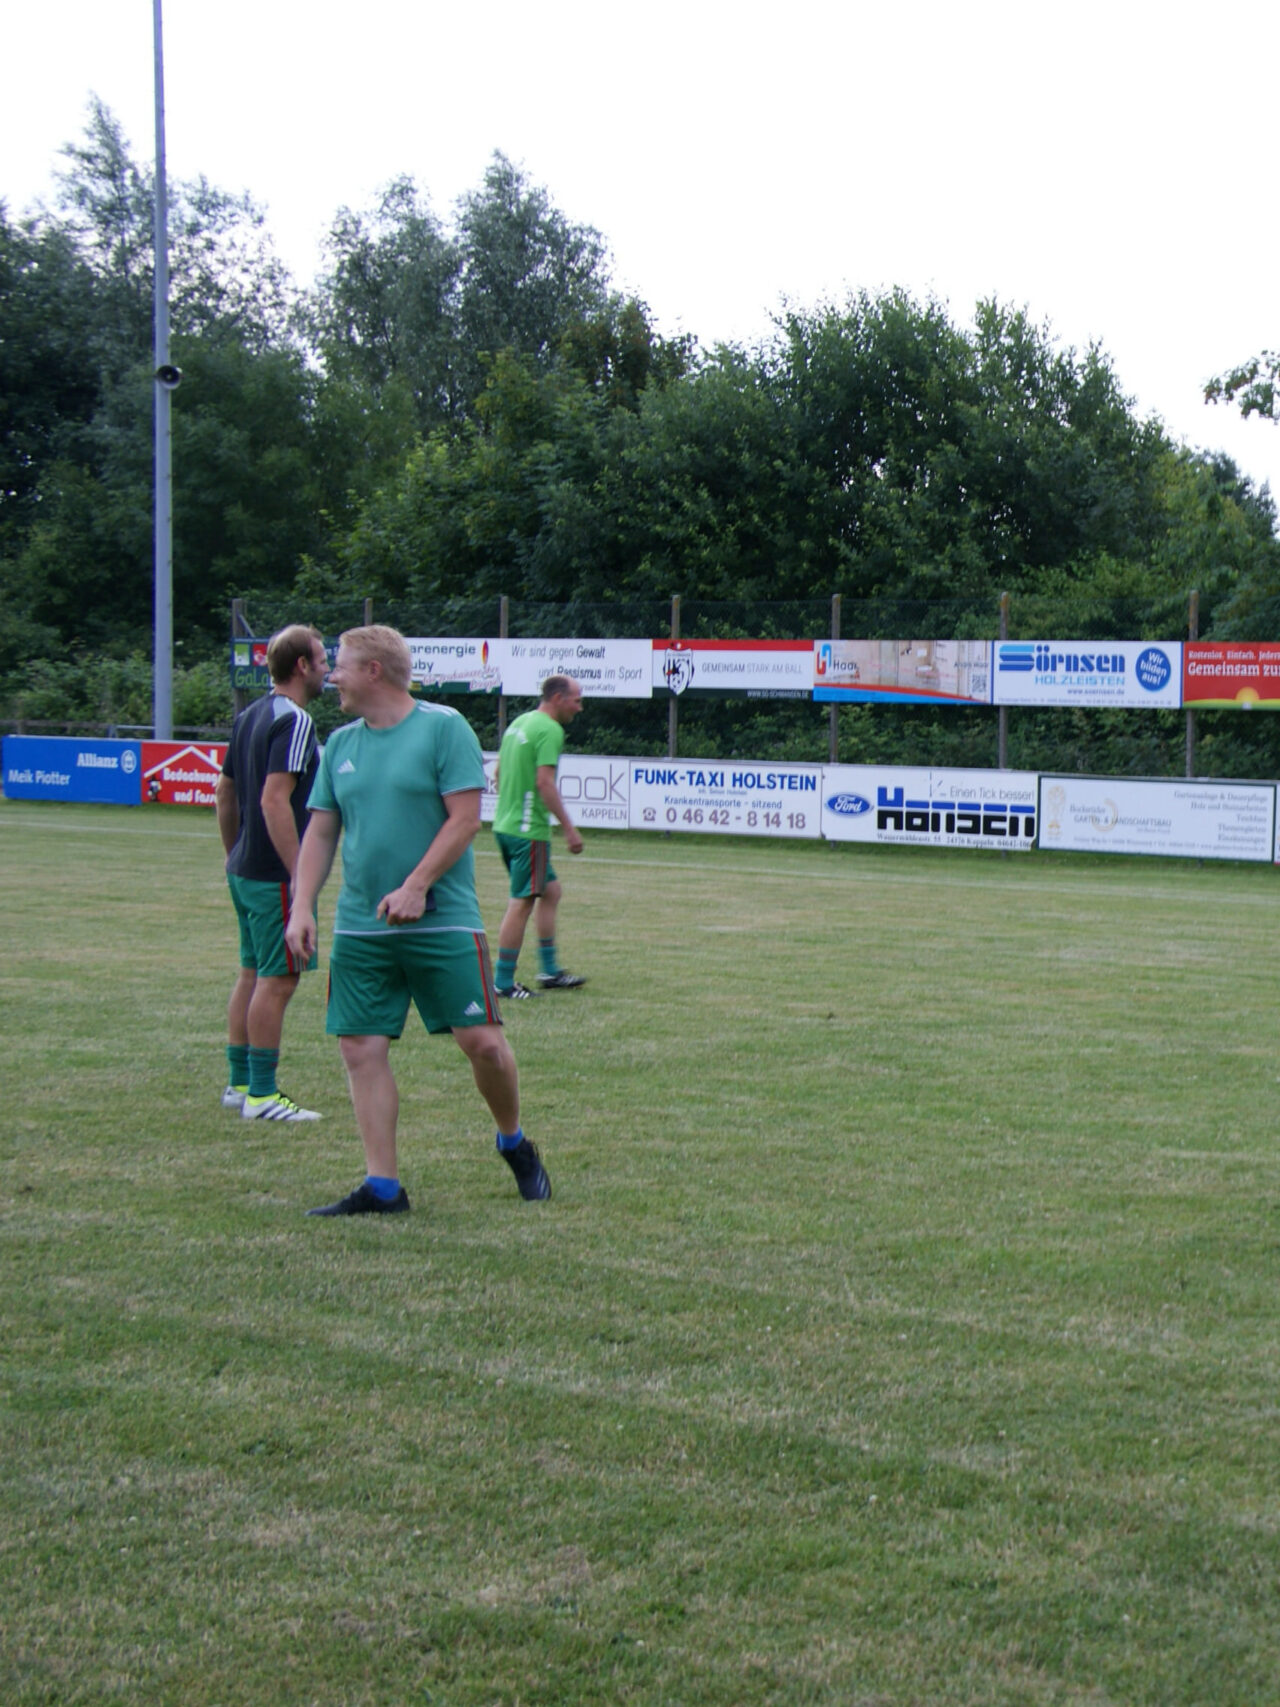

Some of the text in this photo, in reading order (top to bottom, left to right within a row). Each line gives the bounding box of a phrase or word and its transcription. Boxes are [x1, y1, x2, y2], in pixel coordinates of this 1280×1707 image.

[410, 643, 476, 657] arenergie
[511, 645, 605, 660] Wir sind gegen Gewalt
[1149, 652, 1163, 663] Wir
[411, 659, 434, 672] uby
[702, 663, 803, 675] GEMEINSAM STARK AM BALL
[1140, 660, 1167, 676] bilden
[1188, 661, 1260, 676] Gemeinsam
[234, 667, 269, 687] GaLa
[604, 667, 616, 679] im
[618, 666, 642, 681] Sport
[1035, 675, 1125, 686] HOLZLEISTEN
[1142, 673, 1161, 685] aus!
[77, 753, 118, 769] Allianz
[8, 769, 34, 784] Meik
[163, 767, 218, 786] Bedachung
[559, 764, 627, 802] ook
[634, 769, 816, 791] FUNK-TAXI HOLSTEIN
[174, 790, 193, 803] und
[950, 787, 977, 797] Einen
[664, 796, 742, 808] Krankentransporte
[752, 800, 782, 809] sitzend
[833, 795, 863, 812] Ford
[581, 808, 628, 820] KAPPELN
[666, 807, 677, 823] 0
[683, 808, 704, 825] 46
[709, 809, 730, 825] 42
[747, 811, 758, 827] 8
[763, 812, 781, 829] 14
[787, 813, 806, 829] 18
